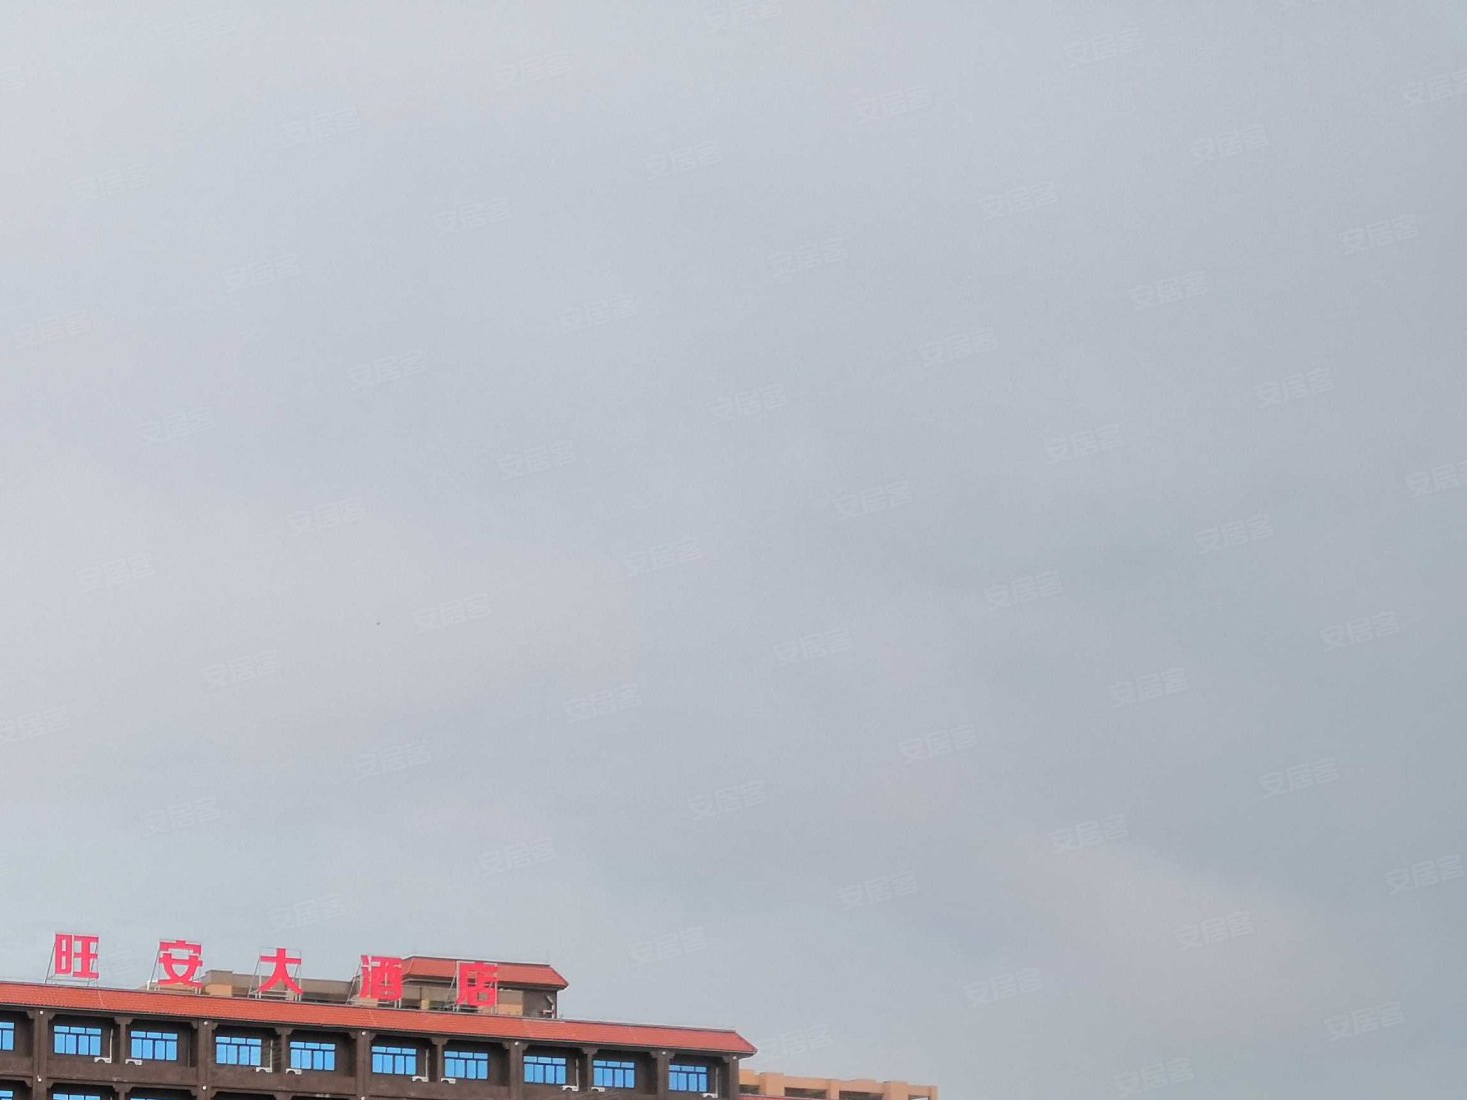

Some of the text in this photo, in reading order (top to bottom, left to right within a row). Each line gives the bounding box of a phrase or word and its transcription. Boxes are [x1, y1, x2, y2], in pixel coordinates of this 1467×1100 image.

[54, 932, 499, 1007] 旺安大酒店
